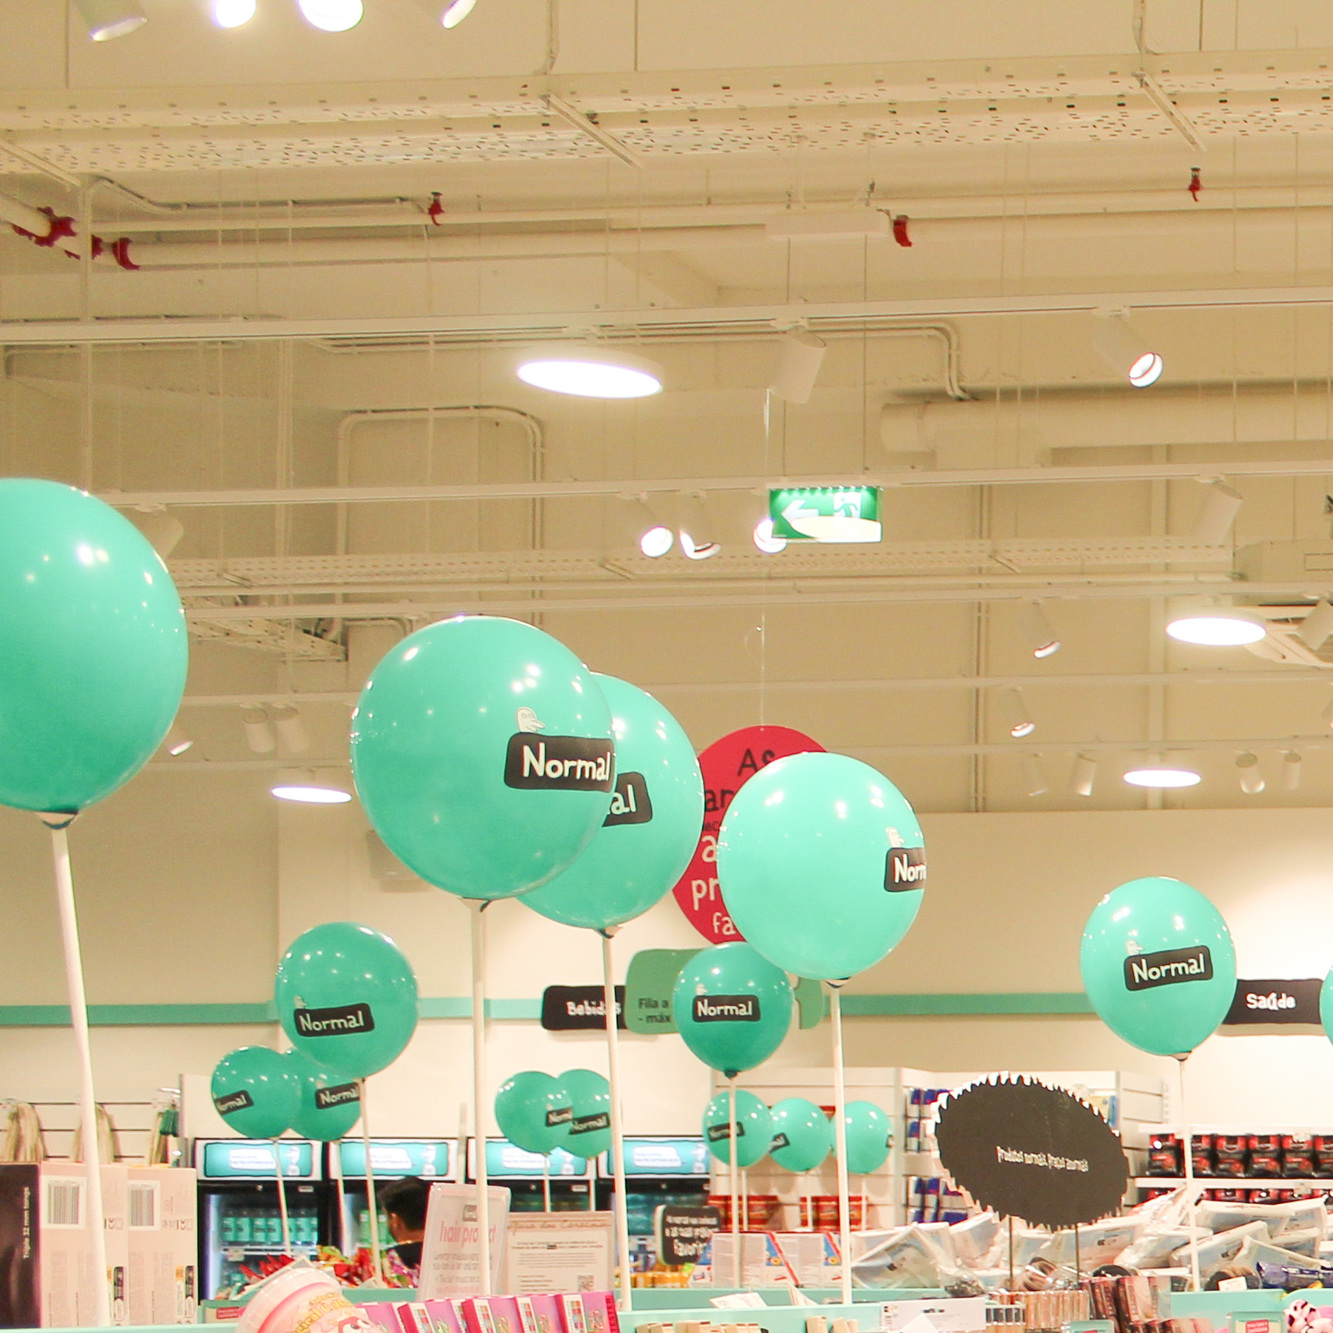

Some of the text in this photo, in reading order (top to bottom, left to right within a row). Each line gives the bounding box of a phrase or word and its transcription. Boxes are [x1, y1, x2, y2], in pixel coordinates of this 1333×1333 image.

[522, 743, 611, 782] Normal
[1132, 955, 1205, 984] Normal
[566, 1001, 622, 1016] Bebids
[638, 998, 669, 1009] Fila a
[696, 1000, 753, 1017] Normal
[1246, 992, 1296, 1011] Saúde
[300, 1010, 365, 1033] Normal
[439, 1220, 460, 1244] hair
